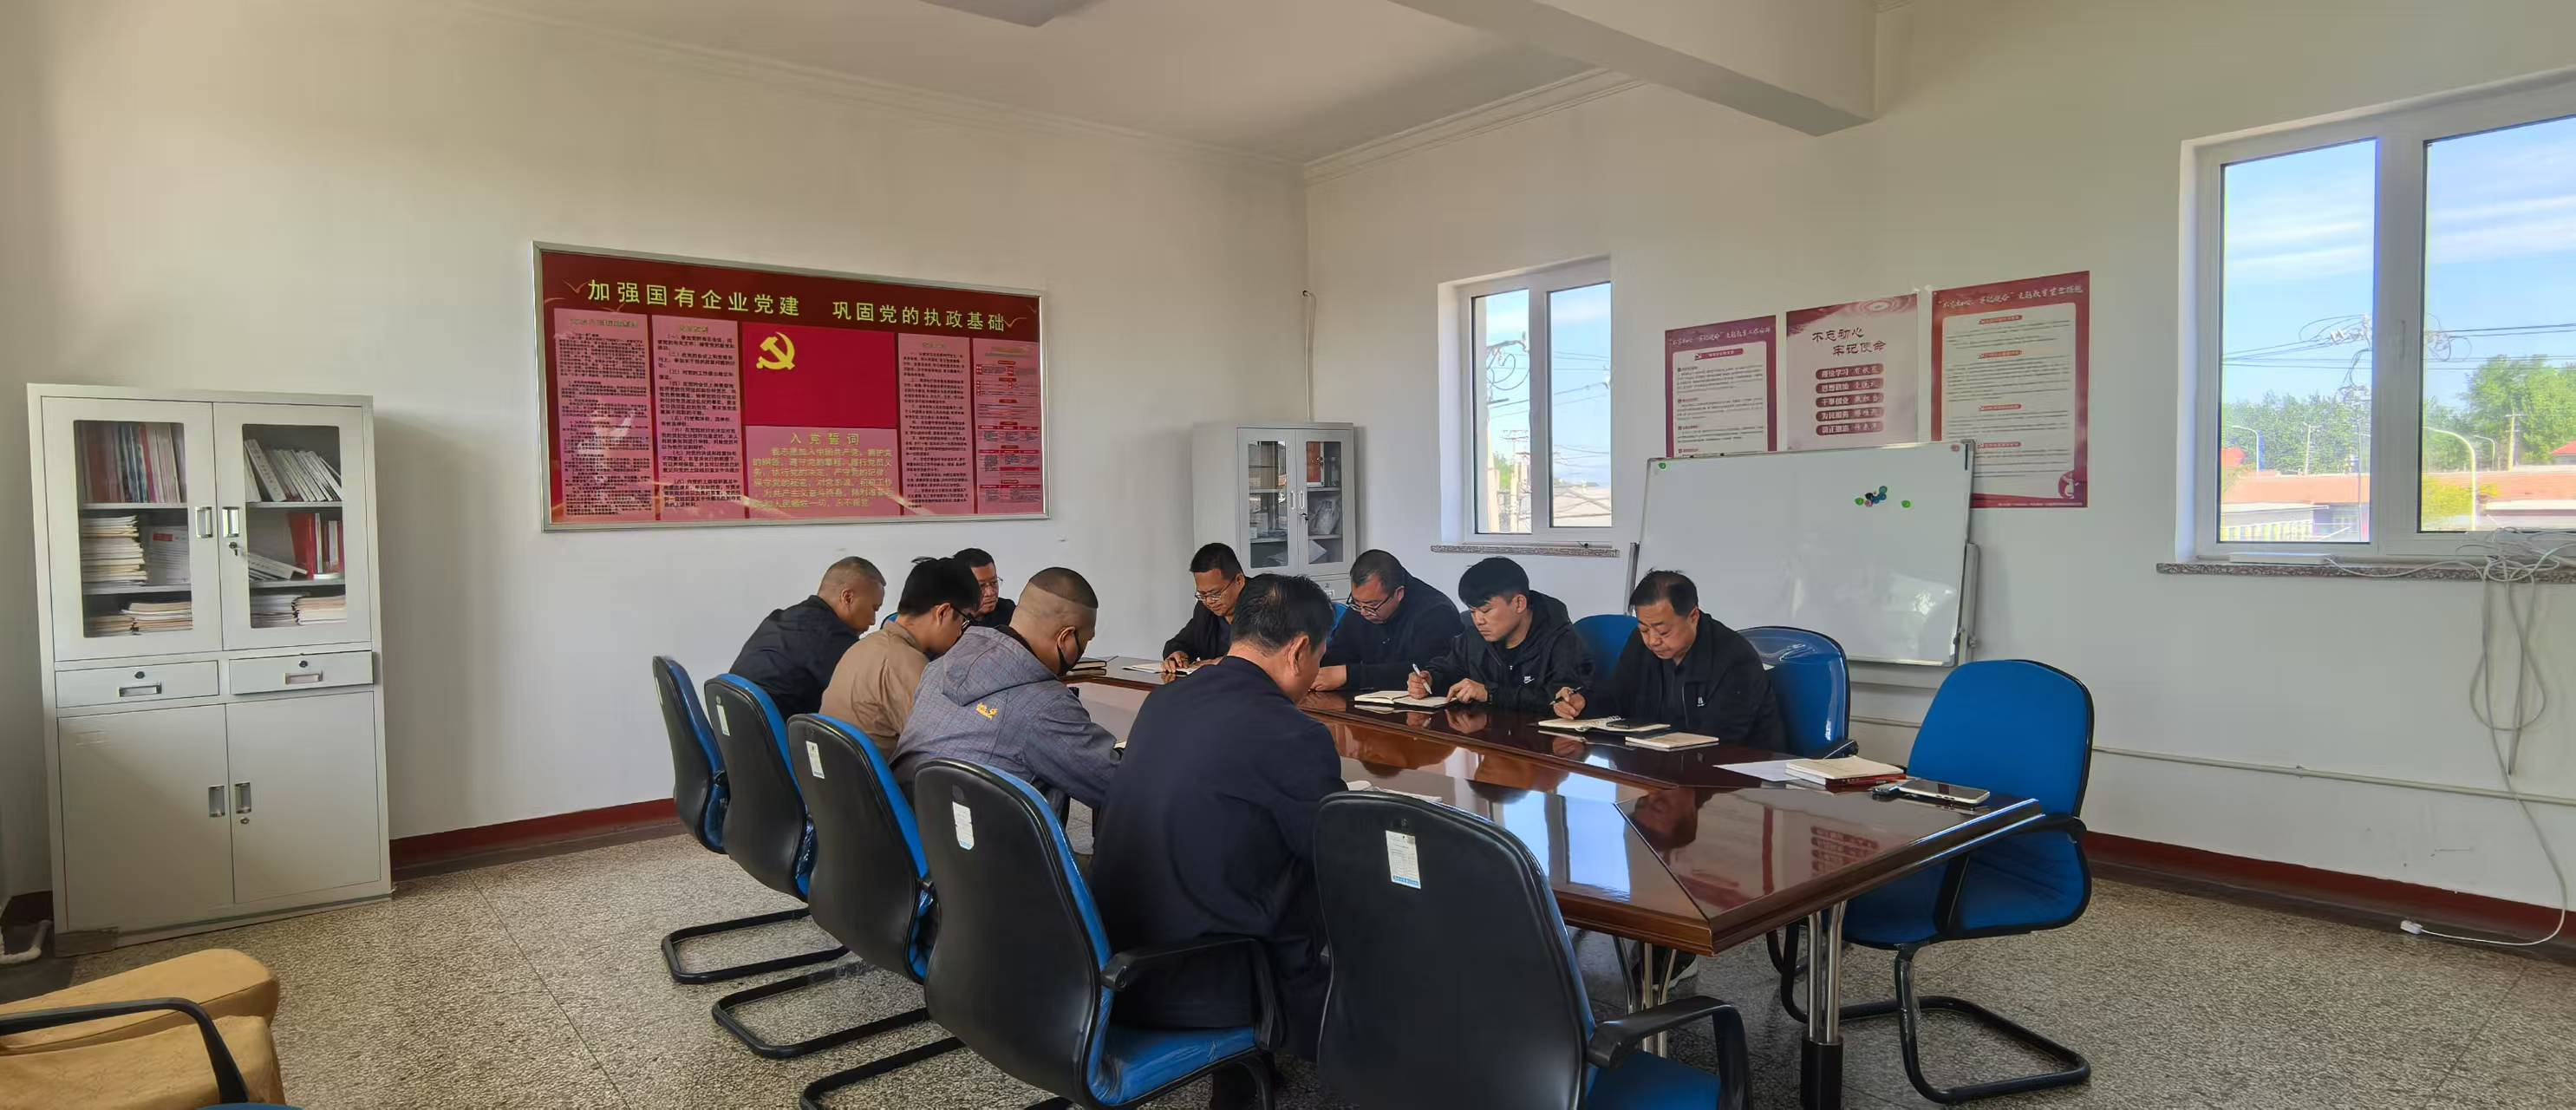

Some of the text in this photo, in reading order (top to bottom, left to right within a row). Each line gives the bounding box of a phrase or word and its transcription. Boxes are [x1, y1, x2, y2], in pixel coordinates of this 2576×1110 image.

[587, 278, 1005, 332] 加强国有企业党建 巩固党的执政基础
[1811, 328, 1864, 343] 不忘初心
[1832, 340, 1887, 356] 牢记使命
[790, 433, 860, 445] 入党誓词
